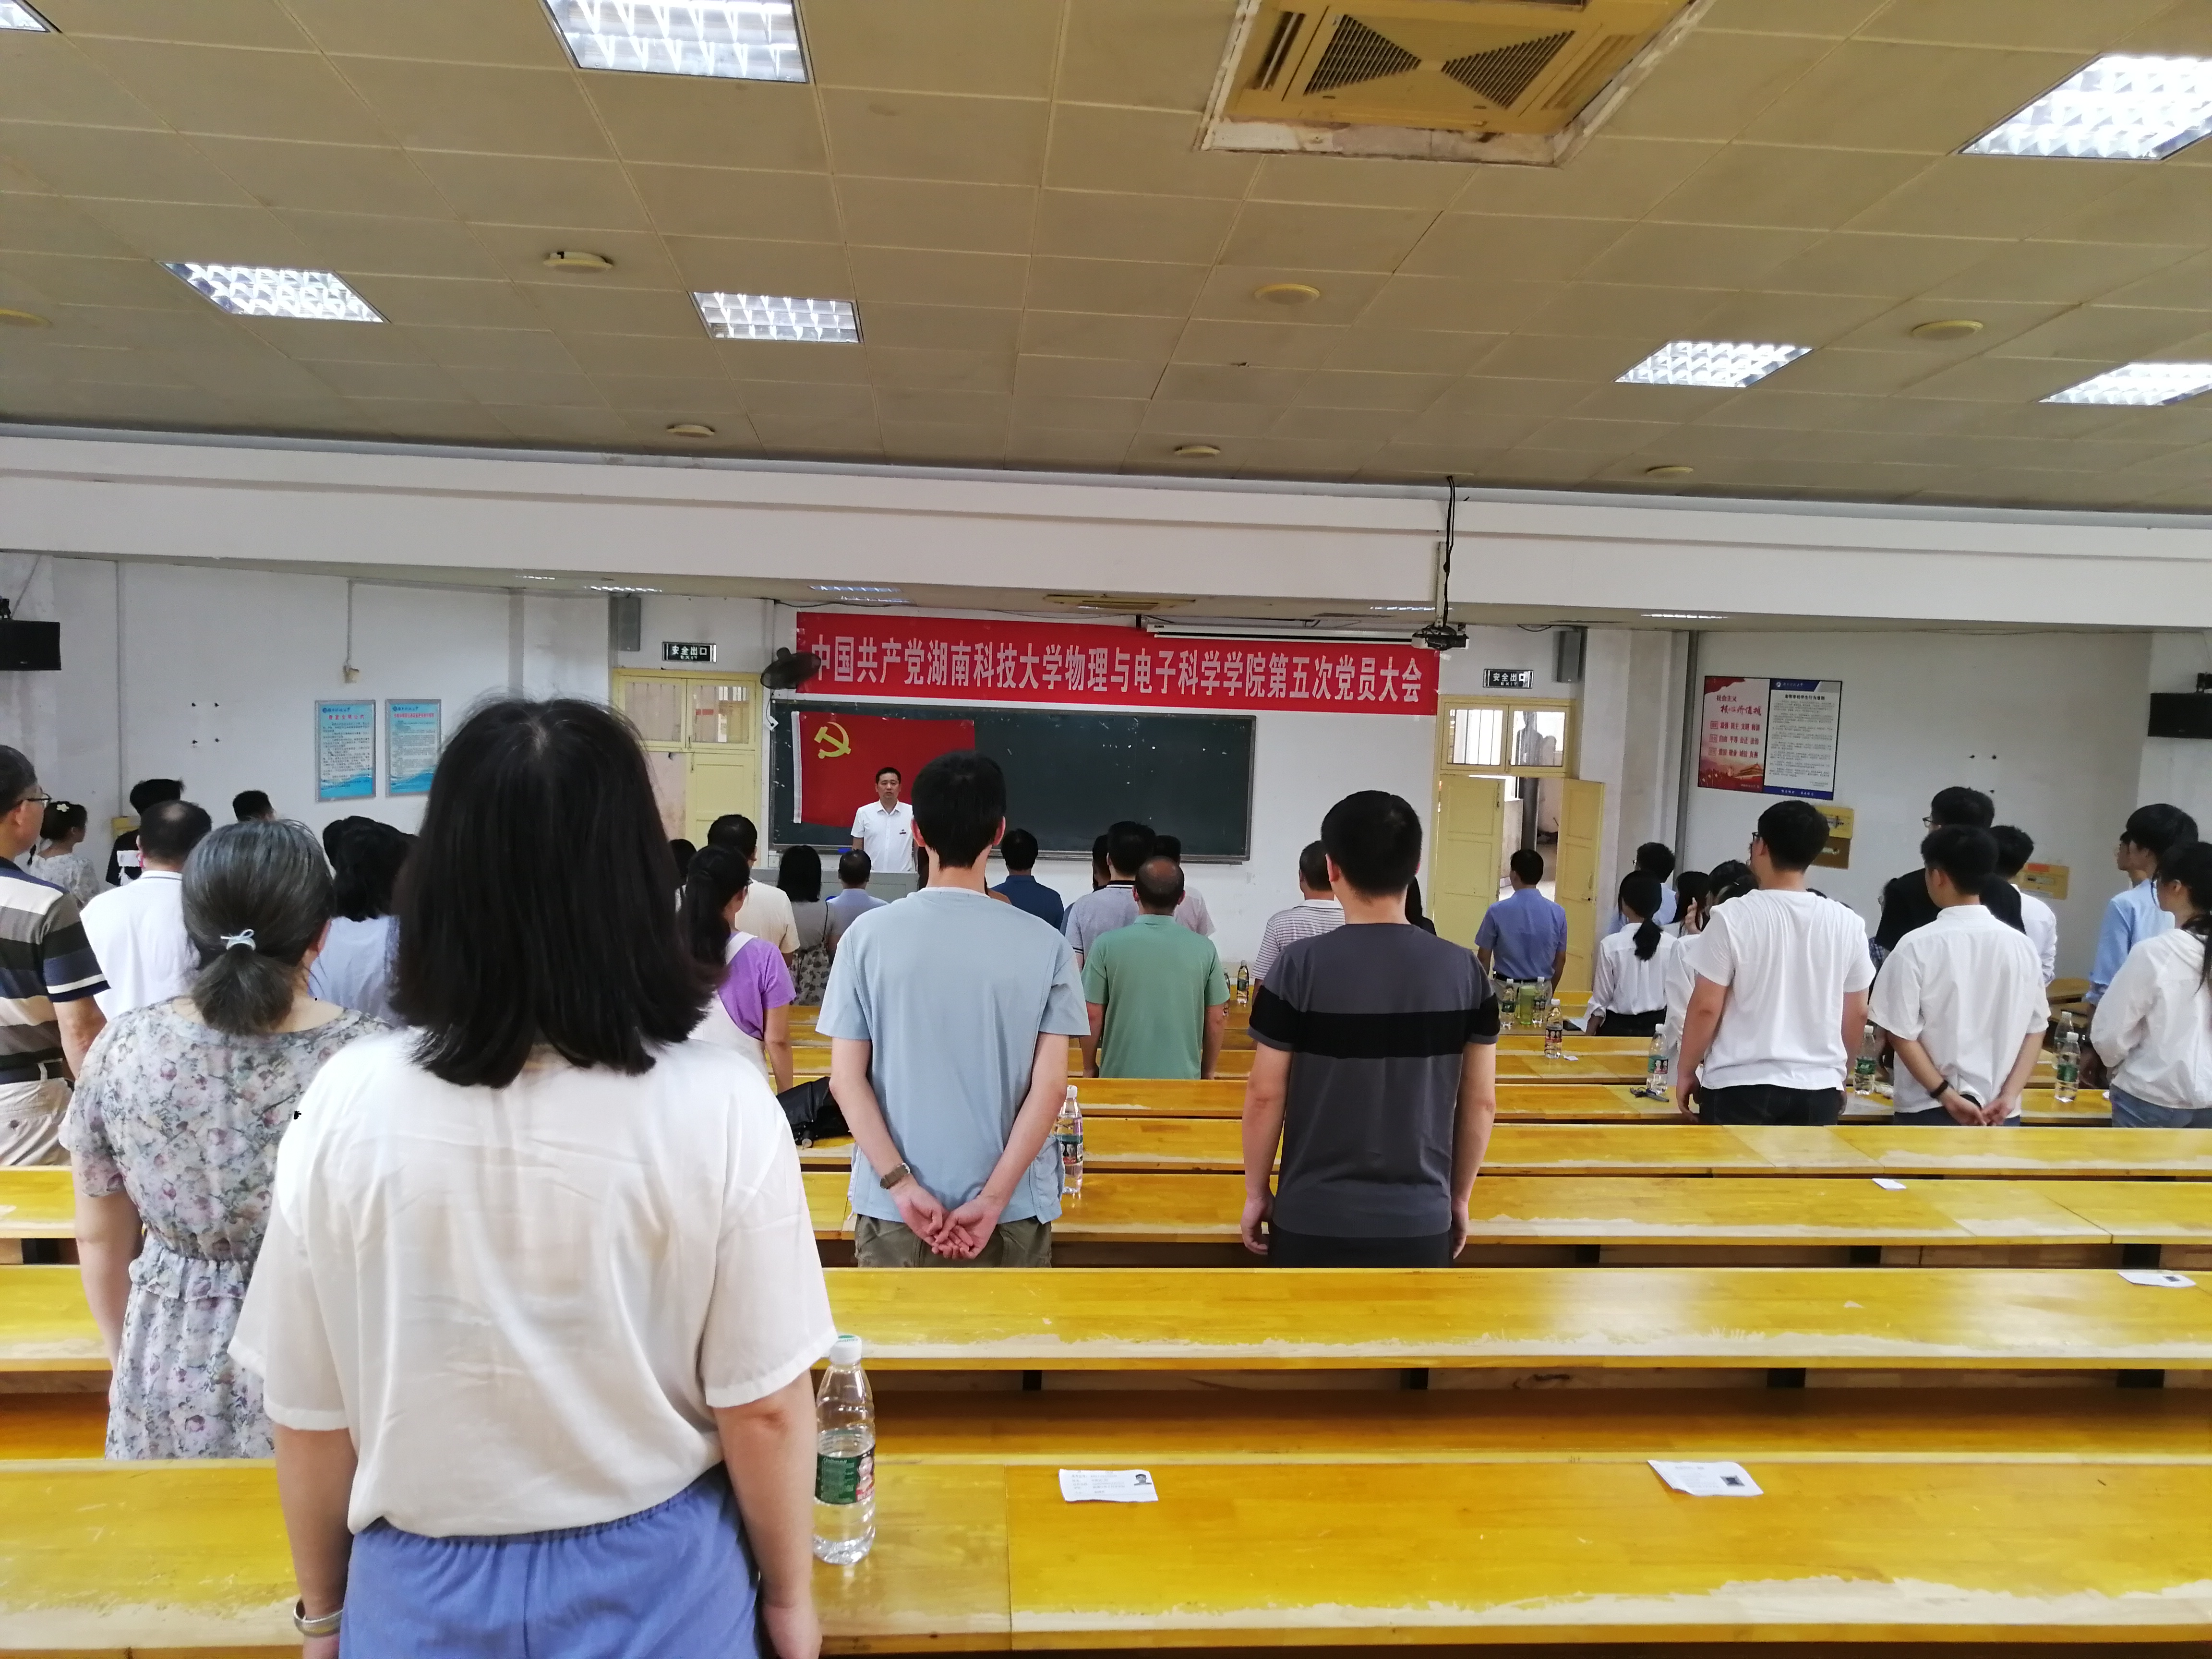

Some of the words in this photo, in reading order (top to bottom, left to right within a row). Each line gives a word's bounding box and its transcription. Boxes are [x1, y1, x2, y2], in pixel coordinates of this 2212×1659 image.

[672, 645, 707, 656] 安全出口
[811, 635, 1422, 702] 中国共产党湖南科技大学物理与电子科学学院第五次党员大会
[1493, 673, 1526, 682] 安全出口
[1720, 704, 1761, 716] 核心价值观
